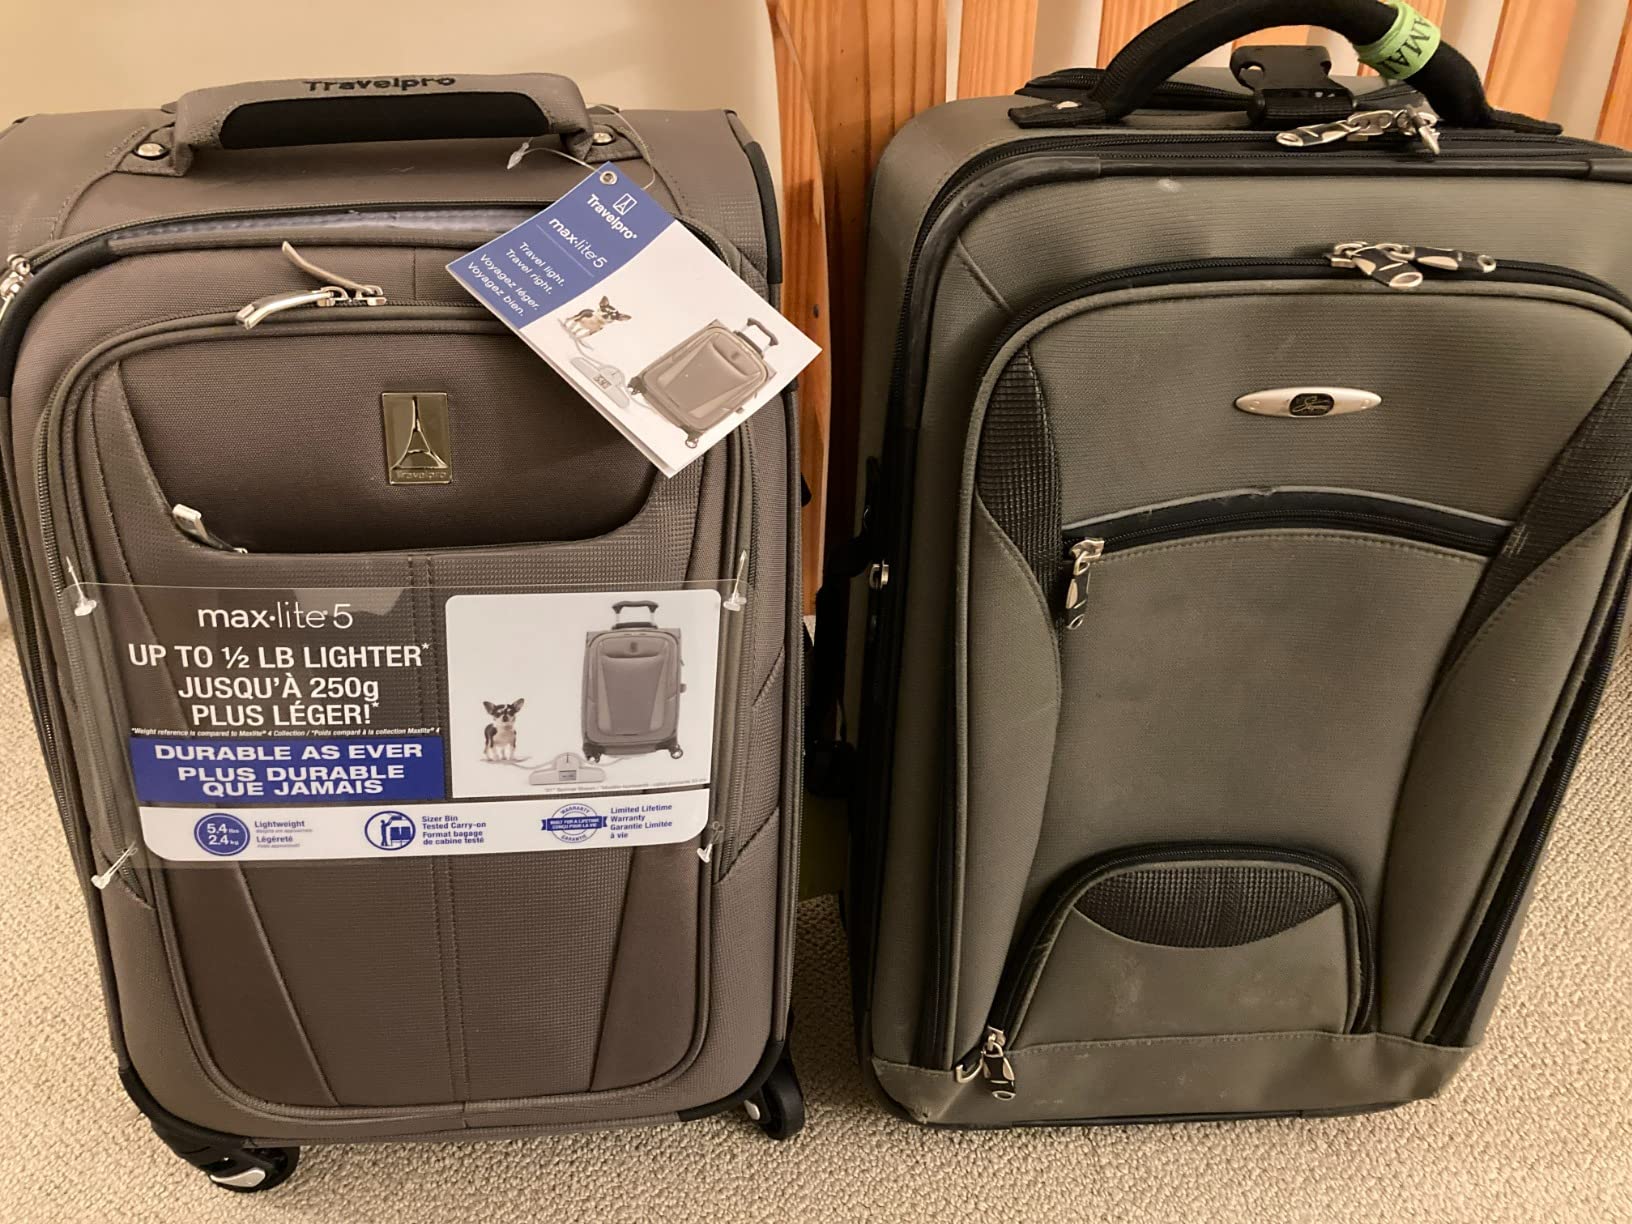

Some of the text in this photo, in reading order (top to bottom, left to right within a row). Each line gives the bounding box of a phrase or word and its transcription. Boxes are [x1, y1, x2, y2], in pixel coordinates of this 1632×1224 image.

[302, 77, 456, 91] Travelpro
[519, 242, 565, 287] Travel light.
[505, 248, 552, 295] Travel right.
[480, 253, 539, 311] Voyagez léger.
[467, 261, 524, 317] Voyagez bien.
[129, 643, 166, 667] UP
[174, 645, 213, 669] TO
[259, 646, 294, 669] LB
[178, 672, 379, 702] JUSQU'À 250g
[192, 704, 264, 727] PLUS
[197, 730, 230, 738] compared
[375, 728, 406, 736] collection
[154, 743, 423, 761] DURABLE AS EVER
[177, 765, 405, 782] PLUS DURABLE
[202, 779, 383, 798] QUE JAMAIS
[610, 803, 673, 814] Limited Lifetime
[254, 820, 305, 829] Lightweight
[421, 815, 442, 823] Sizer
[610, 814, 646, 823] Warranty
[206, 823, 228, 834] 5.4
[422, 821, 486, 831] Tested Carry-on
[610, 819, 673, 831] Garantie Limitée
[208, 835, 229, 846] 2.4
[422, 830, 483, 840] Format bagage
[435, 837, 462, 845] cabine
[617, 831, 629, 839] vie
